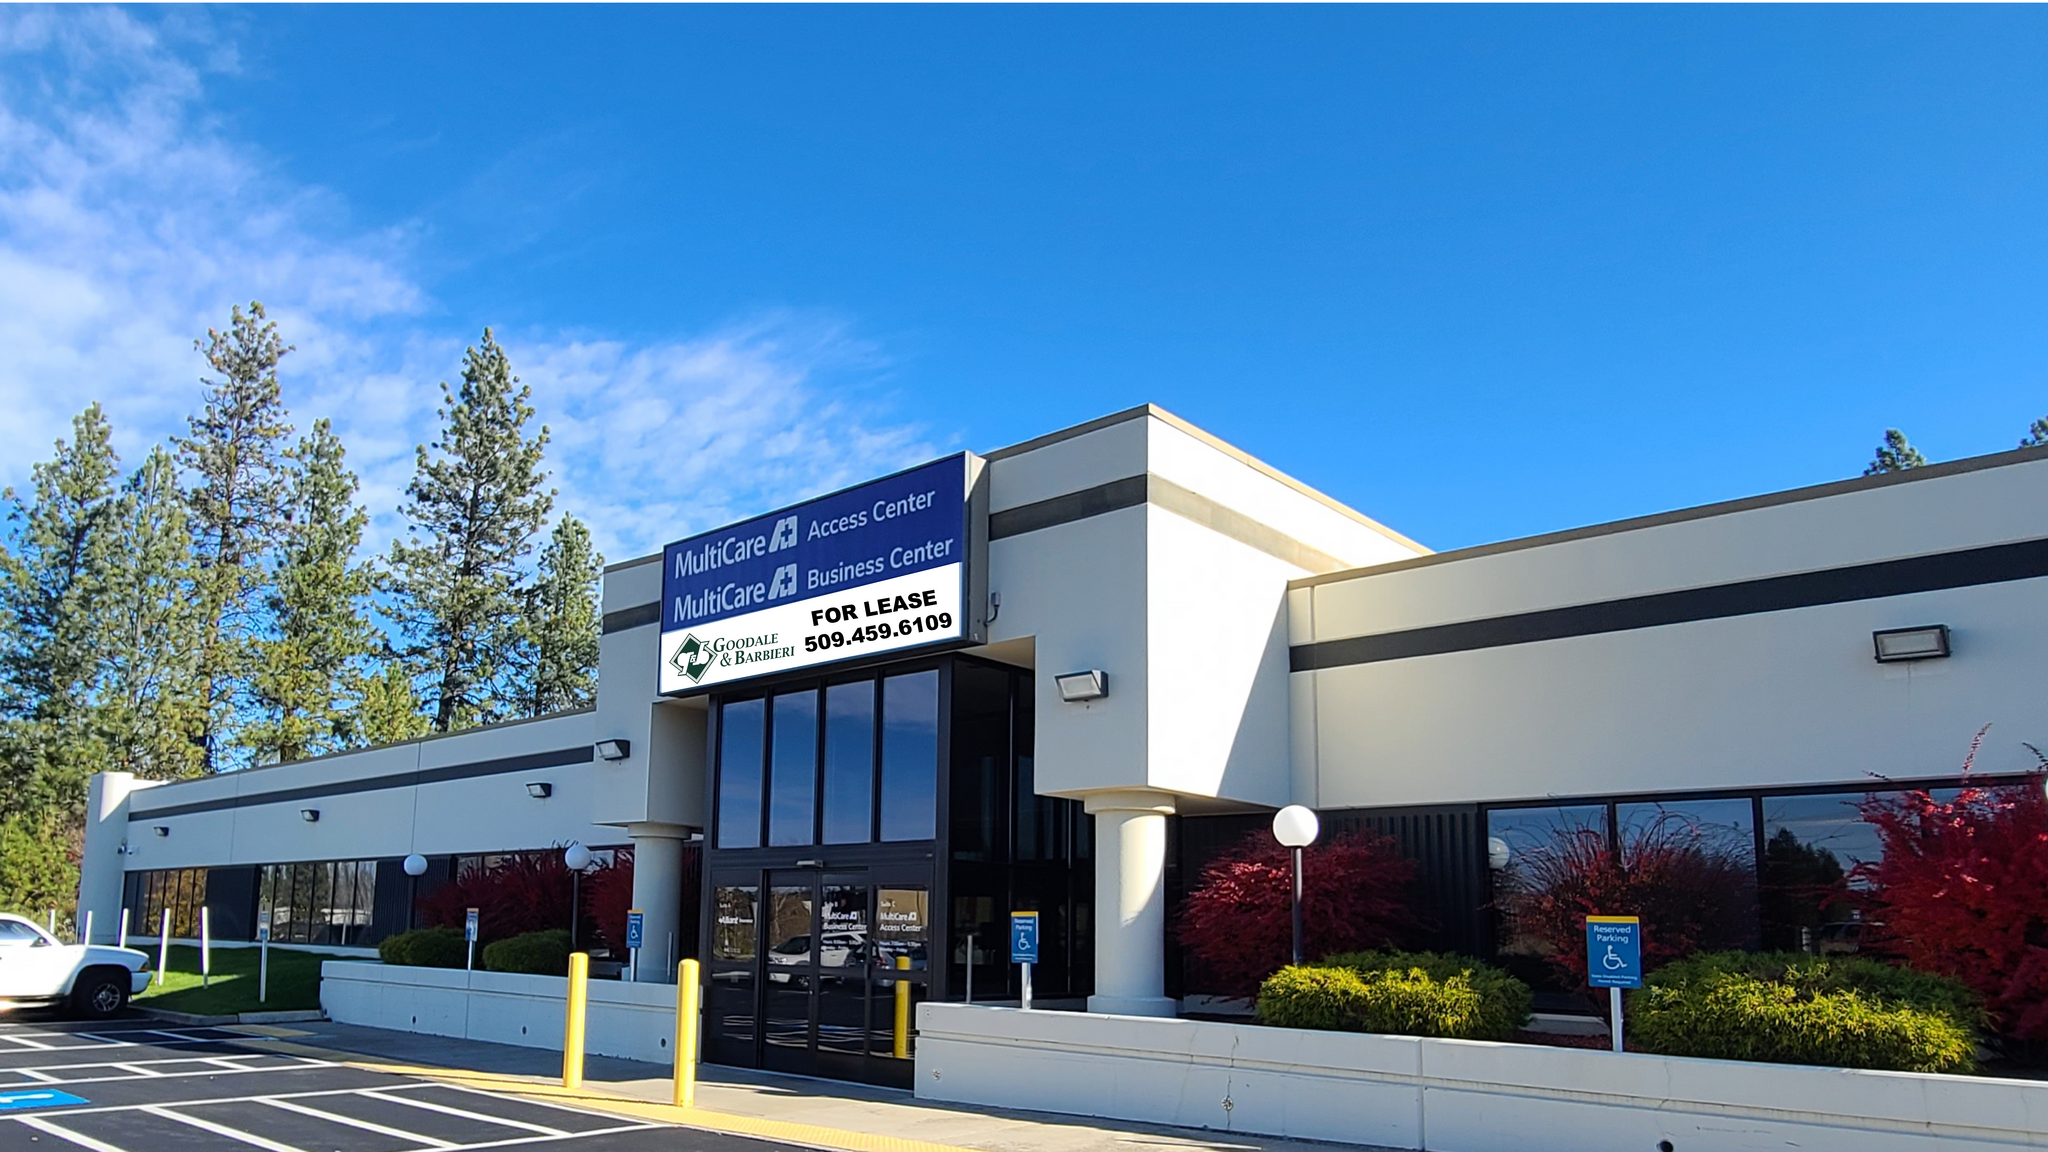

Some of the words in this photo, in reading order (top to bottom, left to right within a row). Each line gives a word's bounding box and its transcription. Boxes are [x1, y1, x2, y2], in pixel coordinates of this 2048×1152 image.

[674, 533, 766, 579] MultiCare
[807, 509, 868, 542] Access
[872, 490, 936, 522] Center
[673, 583, 766, 623] MultiCare
[807, 557, 884, 590] Business
[889, 538, 954, 569] Center
[811, 604, 859, 627] FOR
[864, 589, 938, 617] LEASE
[805, 612, 952, 652] 509.459.6109
[720, 652, 733, 668] &
[880, 912, 908, 921] MultiCare
[823, 922, 848, 930] Business
[879, 923, 901, 931] Access
[901, 924, 922, 932] Center
[1594, 925, 1631, 933] Reserved
[1597, 934, 1628, 944] Parking
